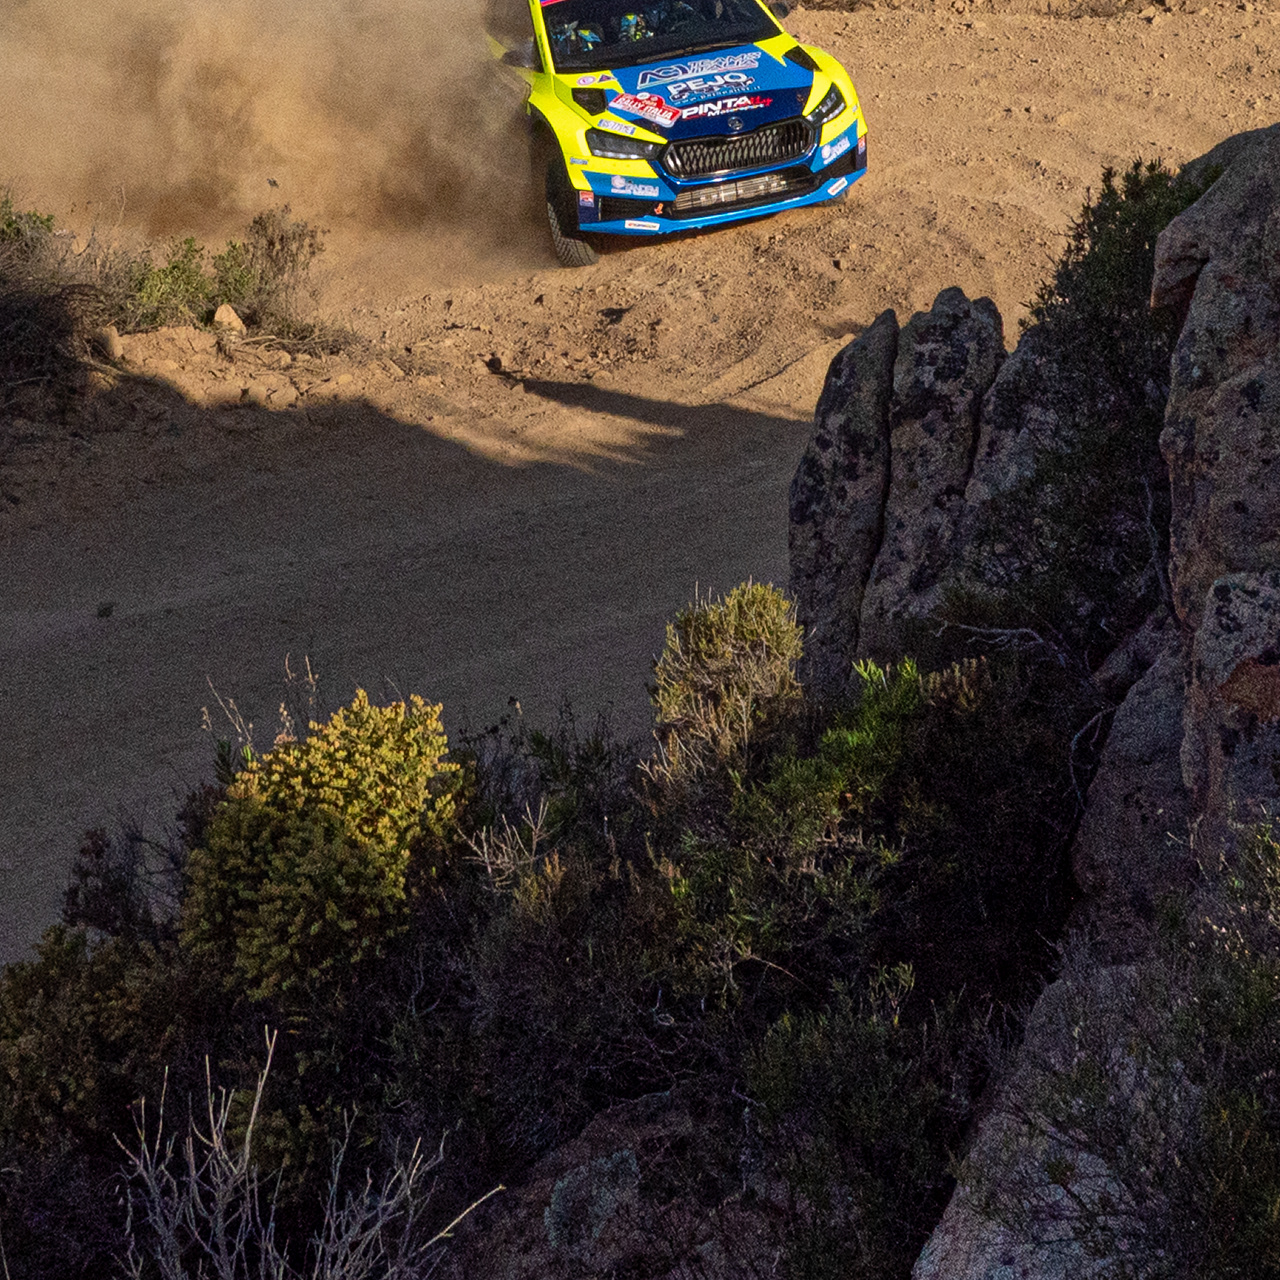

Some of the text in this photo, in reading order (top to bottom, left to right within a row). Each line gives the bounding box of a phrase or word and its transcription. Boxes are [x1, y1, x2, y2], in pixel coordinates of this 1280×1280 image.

[667, 72, 747, 95] PEJO
[615, 97, 646, 109] RALLY
[643, 104, 674, 120] ITALIA
[682, 95, 751, 119] PINTA
